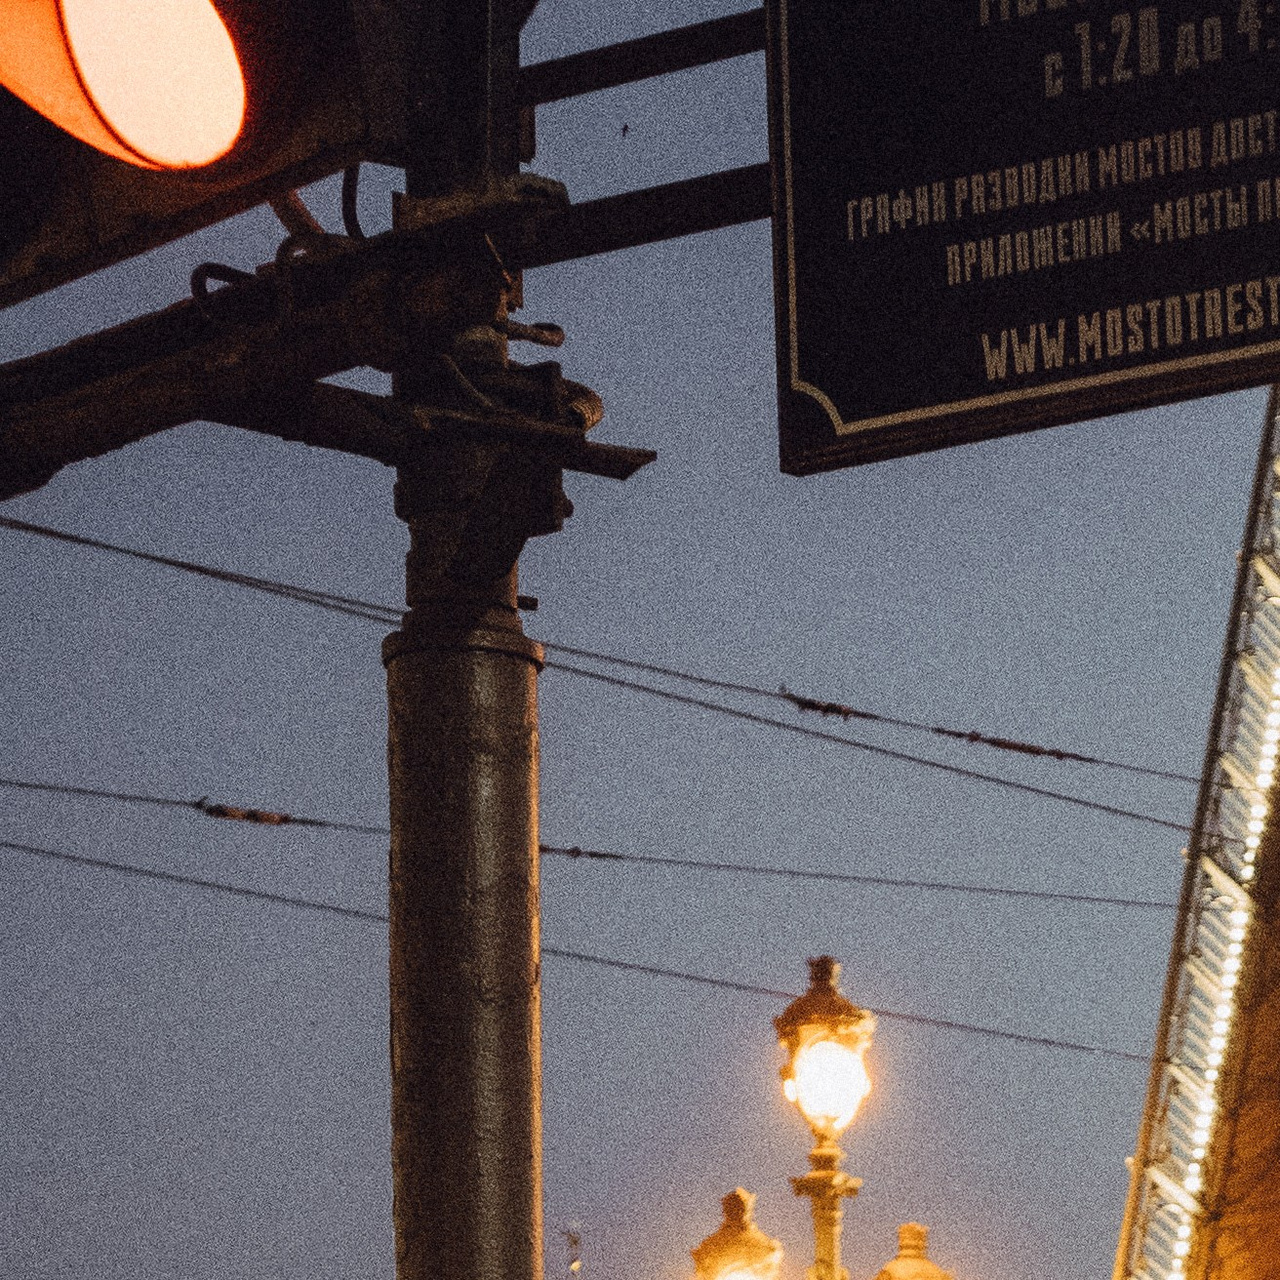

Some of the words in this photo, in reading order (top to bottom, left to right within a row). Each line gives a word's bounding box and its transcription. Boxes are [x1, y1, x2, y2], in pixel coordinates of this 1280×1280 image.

[1074, 6, 1160, 90] 1:20
[847, 181, 947, 241] ГРАФИК
[954, 151, 1090, 219] РАЗВОДКИ
[1098, 126, 1202, 189] МОСТОВ
[946, 210, 1122, 286] ПРИЛОЖЕНИИ
[1130, 185, 1249, 244] «МОСТЫ
